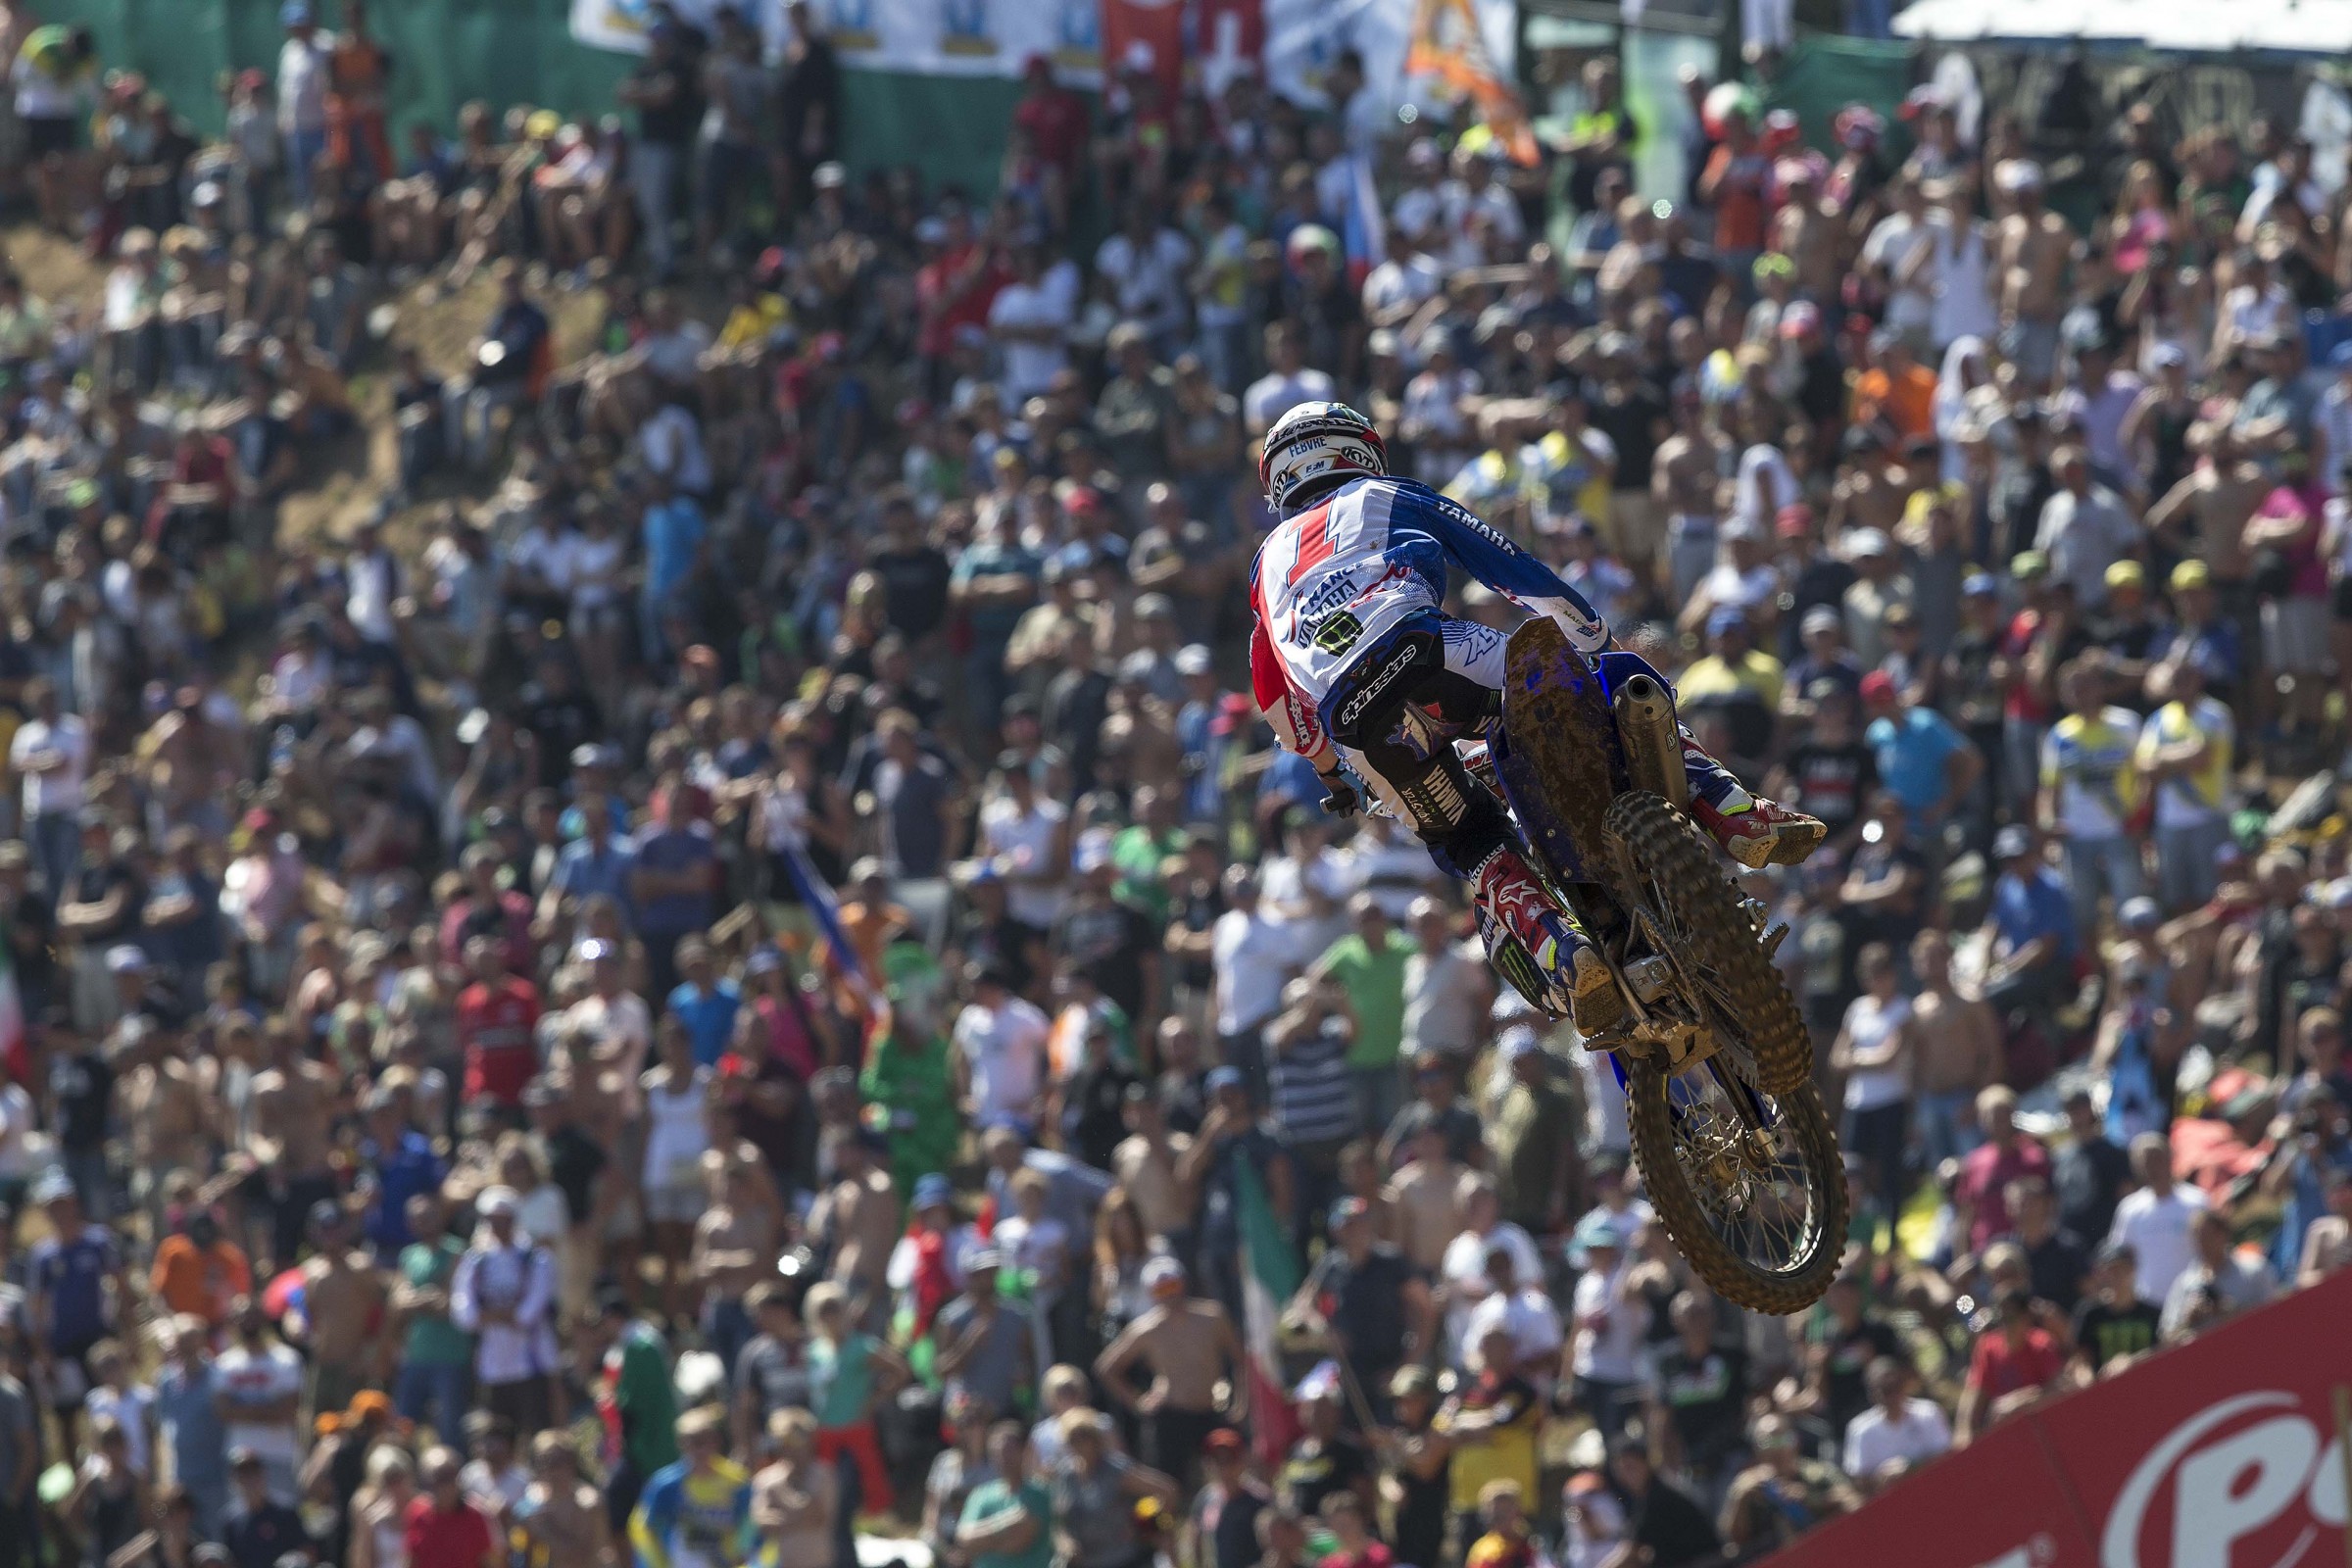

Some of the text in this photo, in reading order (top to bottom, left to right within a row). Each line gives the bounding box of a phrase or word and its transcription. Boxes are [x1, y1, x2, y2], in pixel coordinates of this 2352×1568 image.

[1289, 436, 1328, 458] FEBVRE
[1344, 447, 1375, 469] KYT
[1286, 500, 1341, 589] 1
[1438, 501, 1516, 556] YAMAHA
[1298, 579, 1358, 649] YAMAHA
[1342, 644, 1417, 725] alpinestars
[1417, 789, 1438, 815] NERGY
[1422, 764, 1467, 826] YAMAHA
